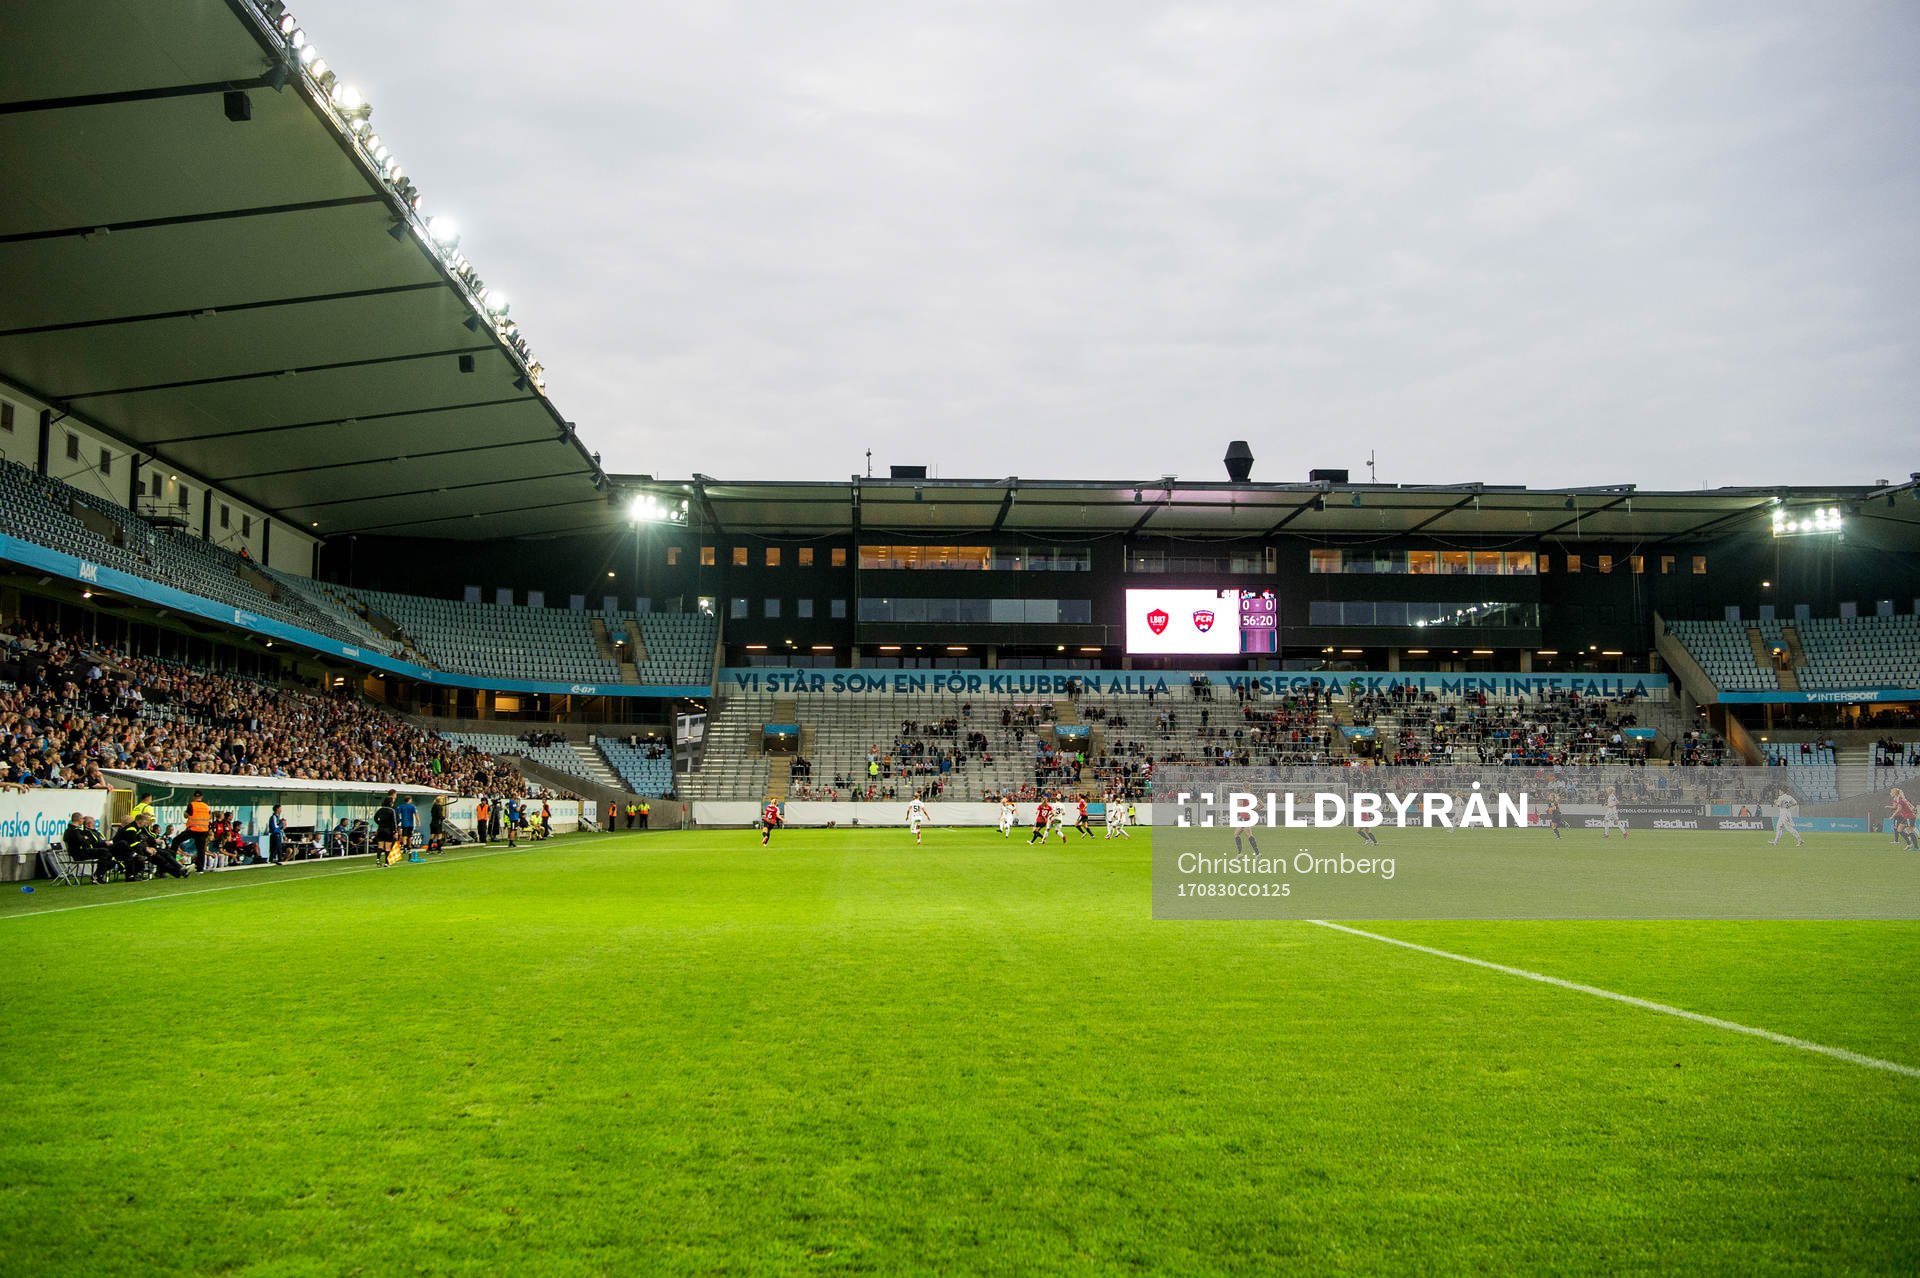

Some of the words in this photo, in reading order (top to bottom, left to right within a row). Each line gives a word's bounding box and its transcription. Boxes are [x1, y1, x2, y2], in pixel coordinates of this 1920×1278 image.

[1242, 600, 1249, 610] 0
[1266, 600, 1273, 610] 0
[1243, 616, 1272, 626] 56:20
[735, 673, 758, 692] VI
[766, 669, 825, 693] STÅR
[832, 673, 886, 693] SOM
[894, 674, 926, 694] EN
[933, 670, 981, 694] FÖR
[989, 674, 1101, 694] KLUBBN
[1108, 675, 1170, 694] ALLA
[1225, 675, 1250, 695] VI
[1441, 677, 1497, 696] MEN
[1505, 677, 1563, 697] INTE
[1818, 692, 1878, 701] INTERSPORT
[0, 811, 30, 837] nska
[1585, 817, 1630, 828] staum
[1653, 819, 1698, 829] stadium
[1719, 820, 1764, 830] stadium
